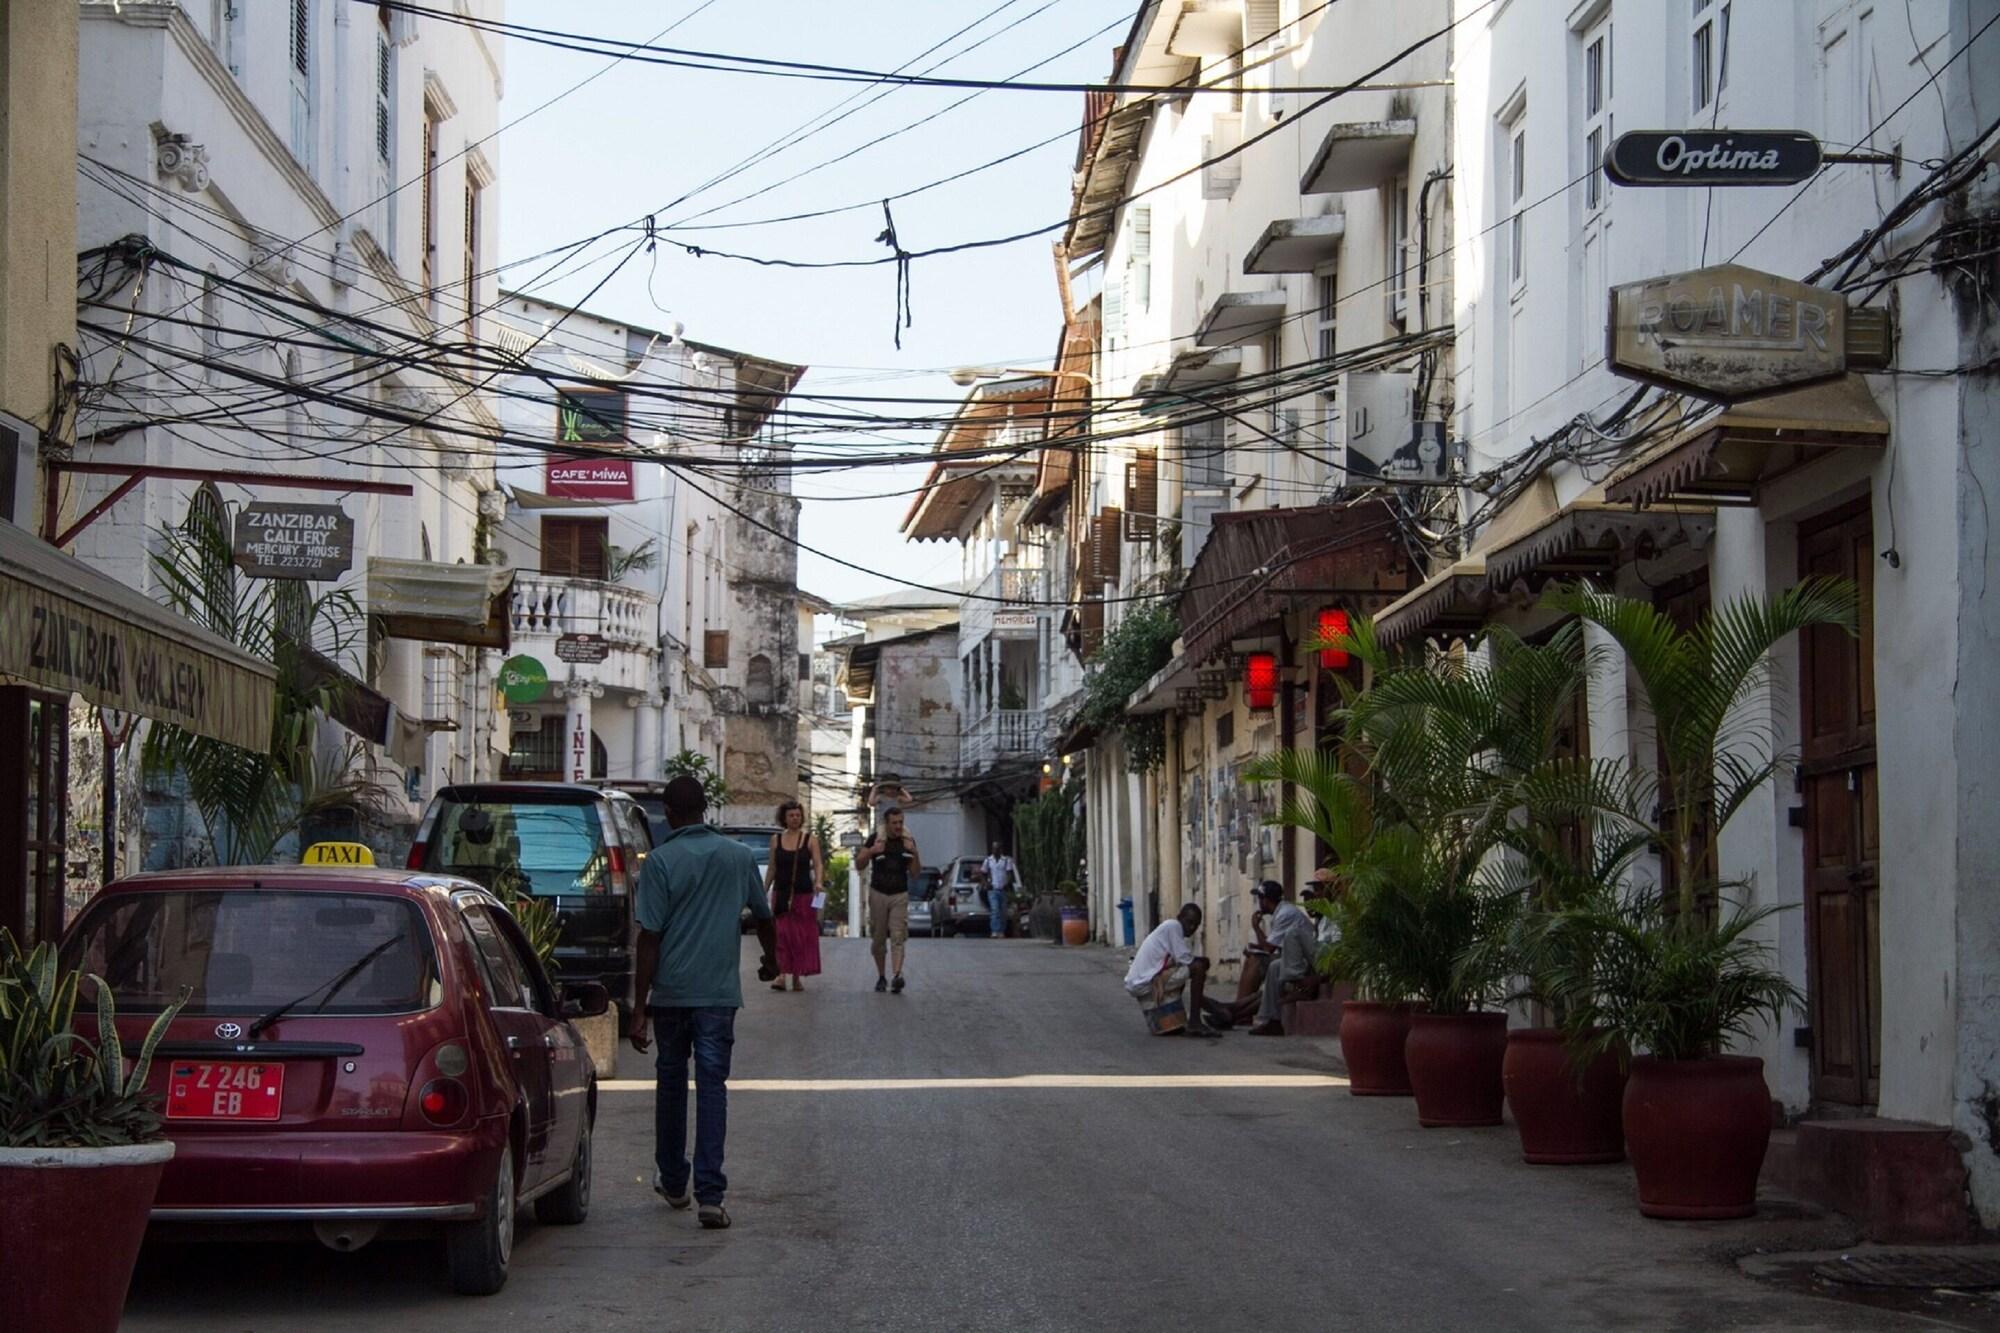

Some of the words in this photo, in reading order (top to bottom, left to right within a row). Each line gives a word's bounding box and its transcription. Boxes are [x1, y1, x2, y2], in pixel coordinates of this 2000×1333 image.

[1656, 135, 1780, 174] Optima
[1637, 283, 1828, 352] ROAMER
[247, 512, 338, 531] ZANZIBAR
[246, 542, 300, 556] MERCURY
[306, 545, 341, 558] HOUSE
[256, 554, 277, 566] TEL
[314, 845, 361, 863] TAXI
[197, 1065, 213, 1088] Z
[217, 1066, 261, 1090] 246
[212, 1091, 242, 1115] EB
